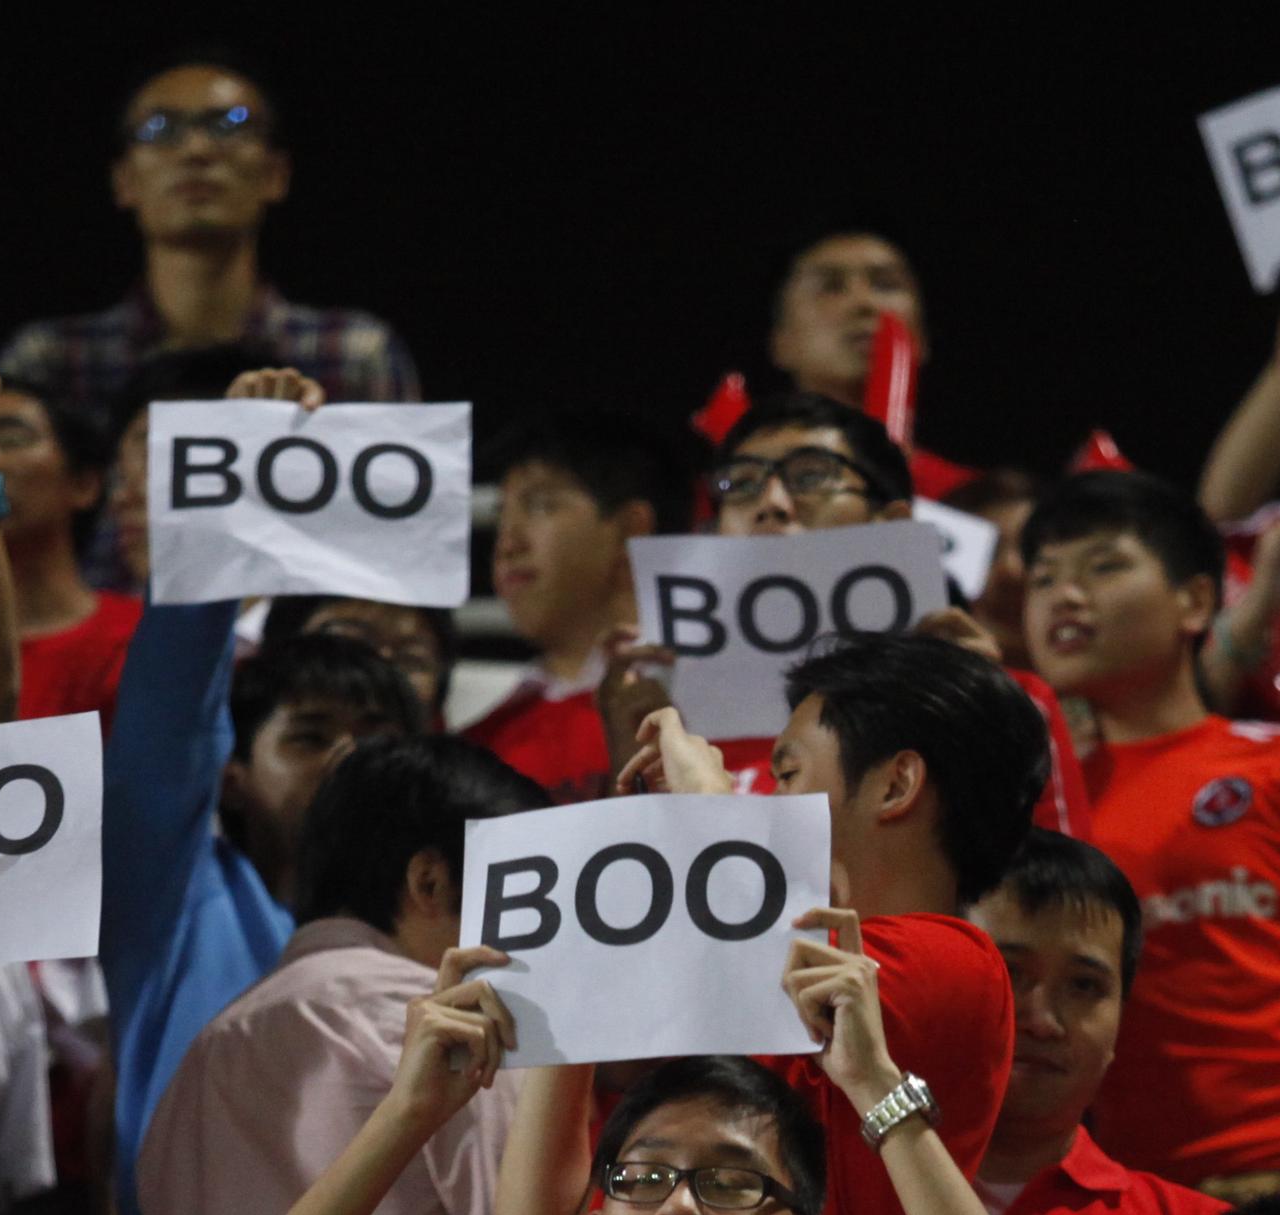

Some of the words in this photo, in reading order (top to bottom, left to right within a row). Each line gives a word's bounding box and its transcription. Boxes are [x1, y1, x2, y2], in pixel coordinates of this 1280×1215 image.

[170, 436, 434, 521] BOO
[655, 563, 913, 658] BOO
[482, 840, 788, 951] BOO
